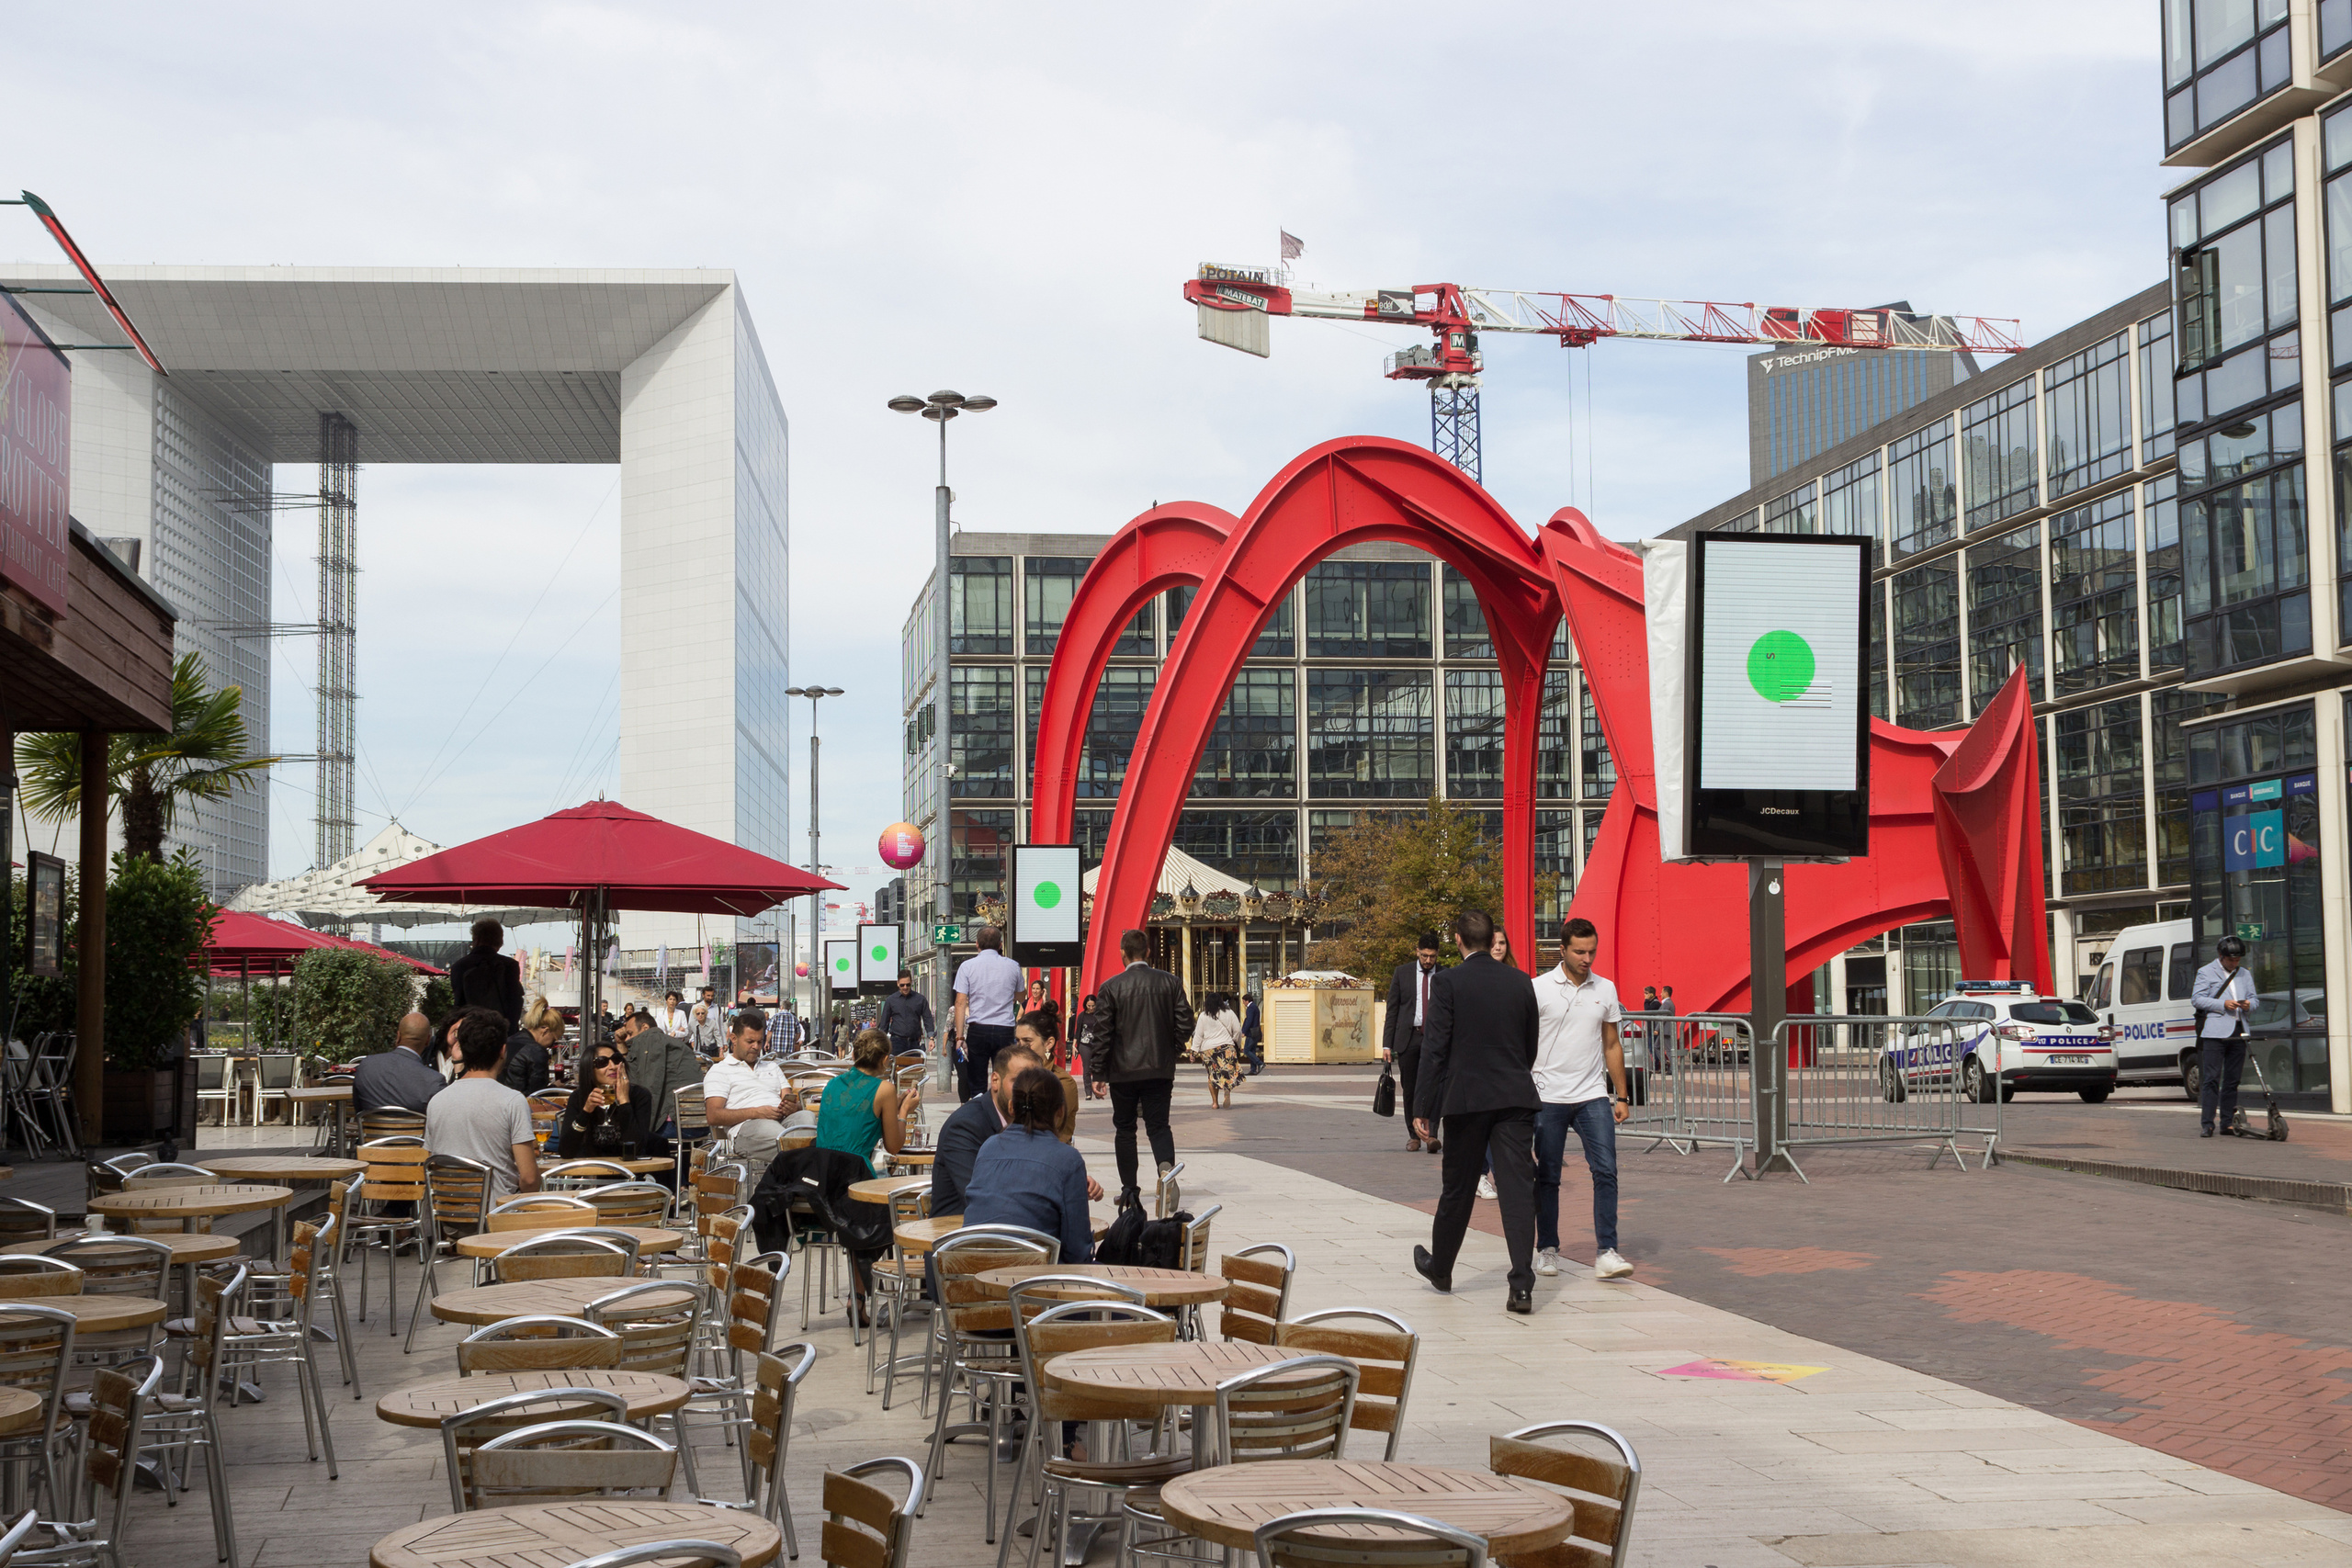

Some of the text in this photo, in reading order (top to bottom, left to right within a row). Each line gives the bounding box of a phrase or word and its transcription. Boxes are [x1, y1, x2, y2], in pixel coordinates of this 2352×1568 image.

[1204, 267, 1264, 283] POTAIN
[1224, 288, 1262, 308] MATEBAT
[1777, 347, 1859, 367] TechnipFMC
[15, 369, 67, 478] GLOBE
[2294, 780, 2311, 789] BANQUE
[1759, 807, 1800, 816] JCDecaux
[2234, 826, 2274, 855] CIC
[2088, 952, 2107, 966] HS
[2123, 1022, 2165, 1041] POLICE
[2050, 1037, 2089, 1045] POLICE
